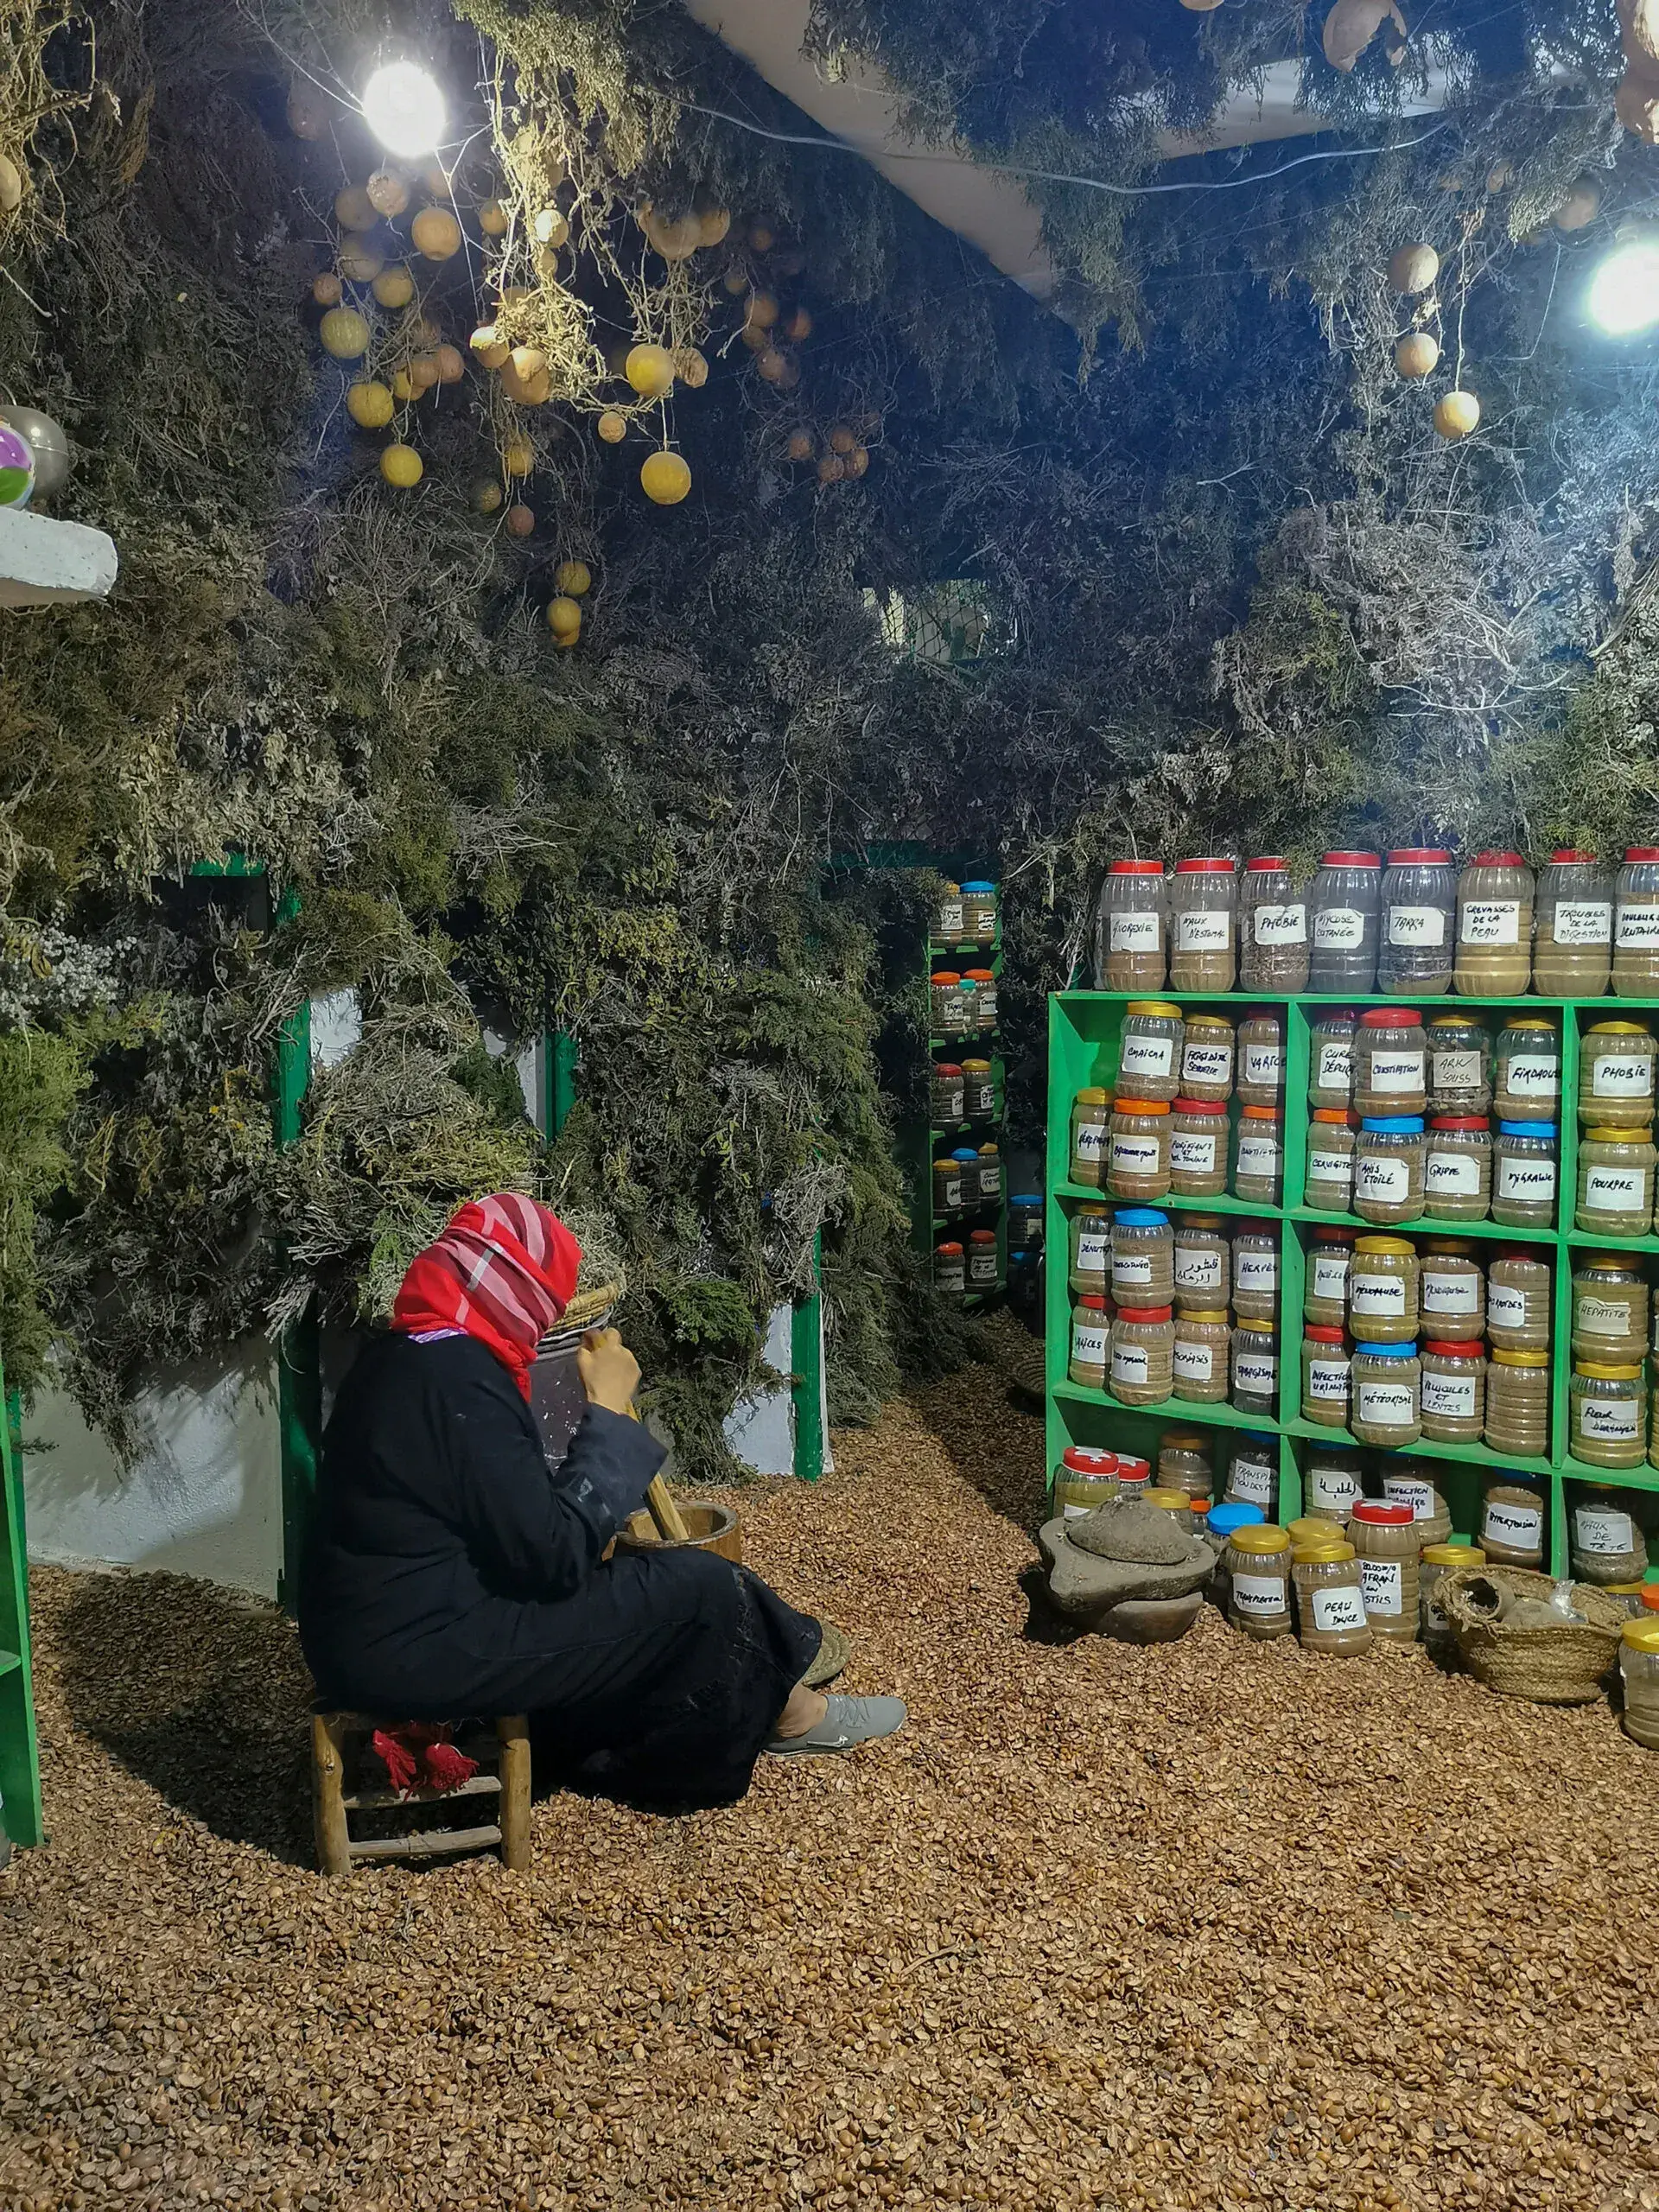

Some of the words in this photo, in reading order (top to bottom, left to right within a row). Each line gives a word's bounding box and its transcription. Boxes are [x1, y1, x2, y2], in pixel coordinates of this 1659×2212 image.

[1466, 906, 1515, 915] CREVASSES
[1183, 917, 1208, 929] MAUX
[1261, 916, 1300, 931] PHOBIE
[1318, 914, 1355, 926] MYCOSE
[1472, 915, 1484, 924] DE
[1112, 919, 1154, 938] ANOREXIE
[1471, 926, 1499, 939] PEAU
[1560, 929, 1607, 941] DIGESTION
[1325, 1048, 1355, 1059] CURE
[1441, 1072, 1471, 1084] SOUSS
[1602, 1065, 1646, 1079] PHOBIE
[1185, 1258, 1218, 1273] قشور
[1581, 1303, 1628, 1318] HEPATITE
[1592, 1531, 1611, 1541] DE
[1324, 1601, 1352, 1613] PEAU
